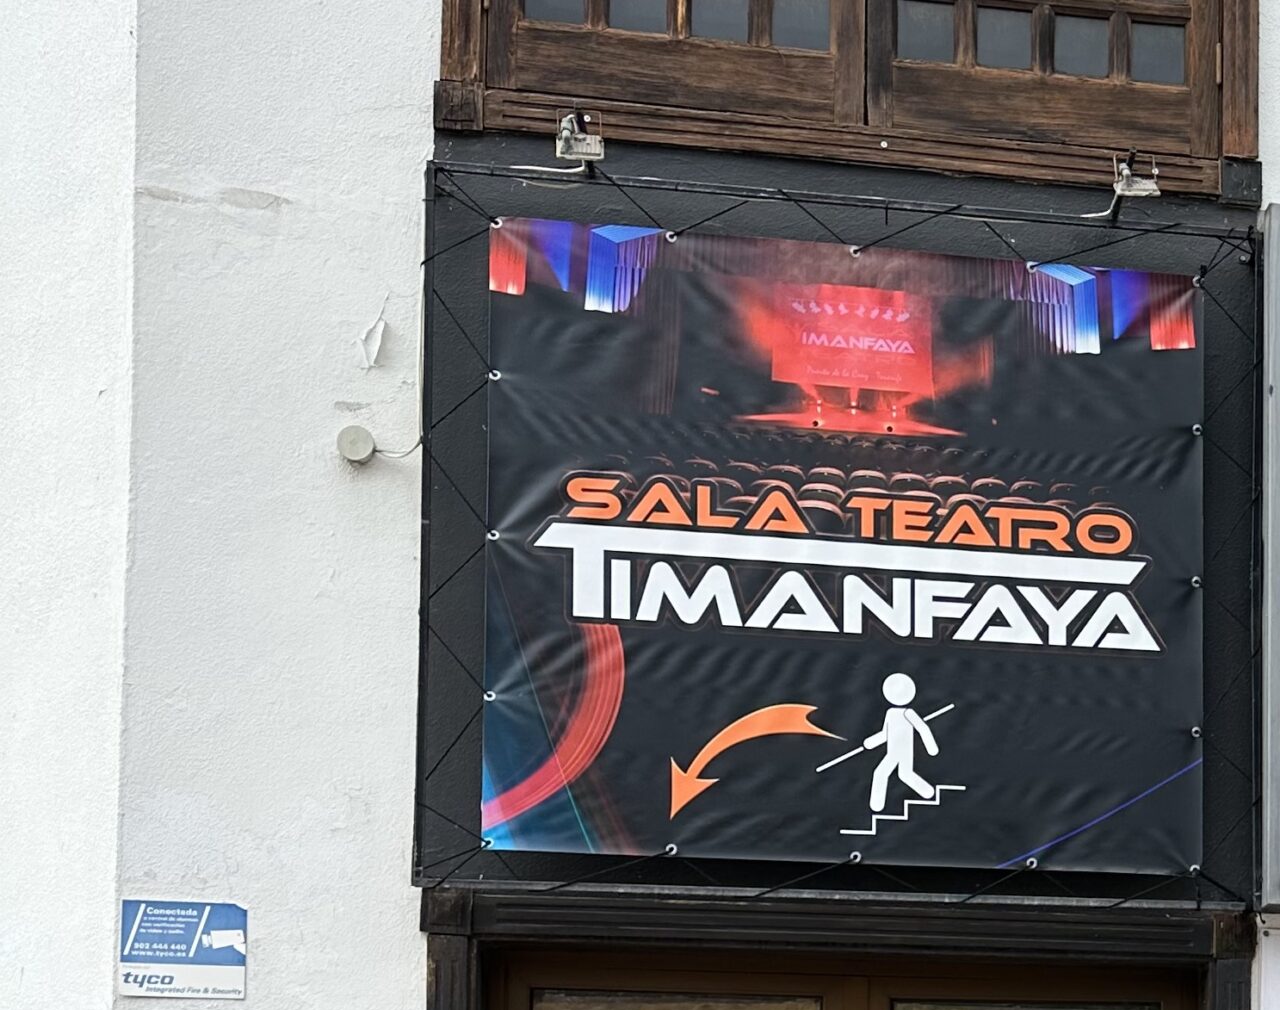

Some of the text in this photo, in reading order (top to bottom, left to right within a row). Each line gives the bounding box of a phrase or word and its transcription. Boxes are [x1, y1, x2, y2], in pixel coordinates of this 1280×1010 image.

[565, 477, 1133, 554] SALA TEATRO
[534, 522, 1161, 652] TIMANFAYA
[122, 971, 175, 988] tyco
[145, 986, 185, 994] Integrated
